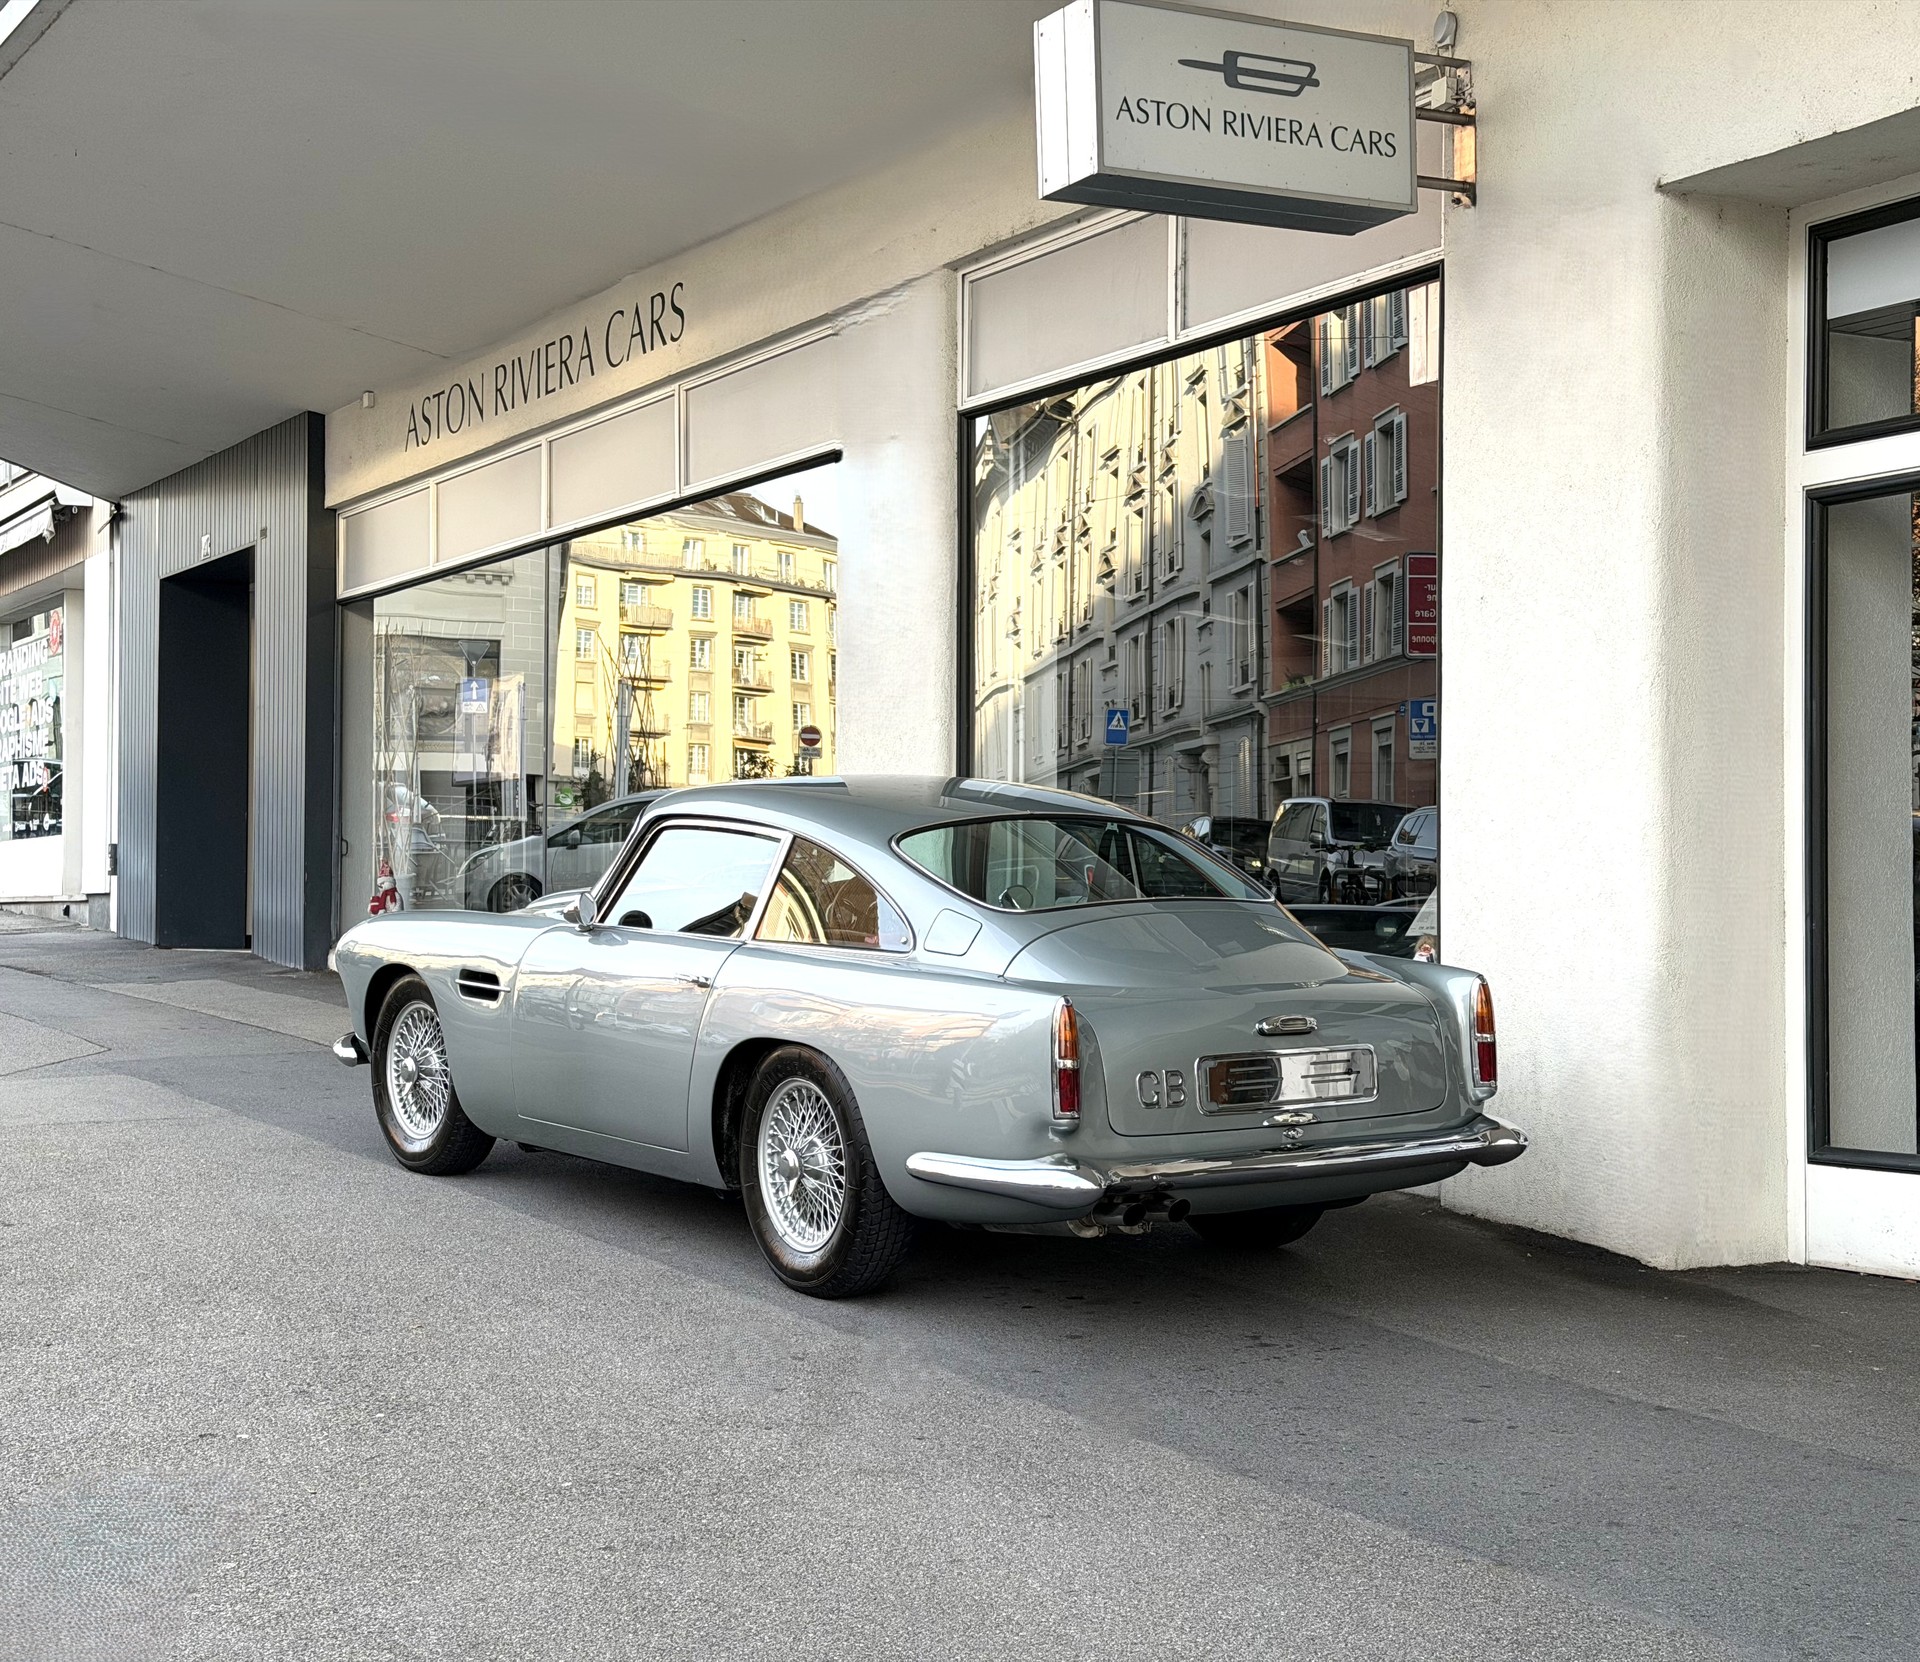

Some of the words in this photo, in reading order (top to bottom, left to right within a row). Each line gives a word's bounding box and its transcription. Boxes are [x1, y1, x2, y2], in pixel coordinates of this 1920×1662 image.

[1116, 95, 1211, 134] ASTON
[1223, 110, 1323, 148] RIVIERA
[1331, 125, 1397, 158] CARS
[405, 372, 485, 452] ASTON
[494, 325, 596, 417] RIVIERA
[605, 282, 685, 368] CARS
[0, 677, 17, 706] ITE
[19, 670, 43, 701] WEB
[30, 696, 54, 727] ADS
[0, 728, 49, 763] APHISME
[22, 760, 44, 788] ADS
[1136, 1069, 1188, 1109] GB
